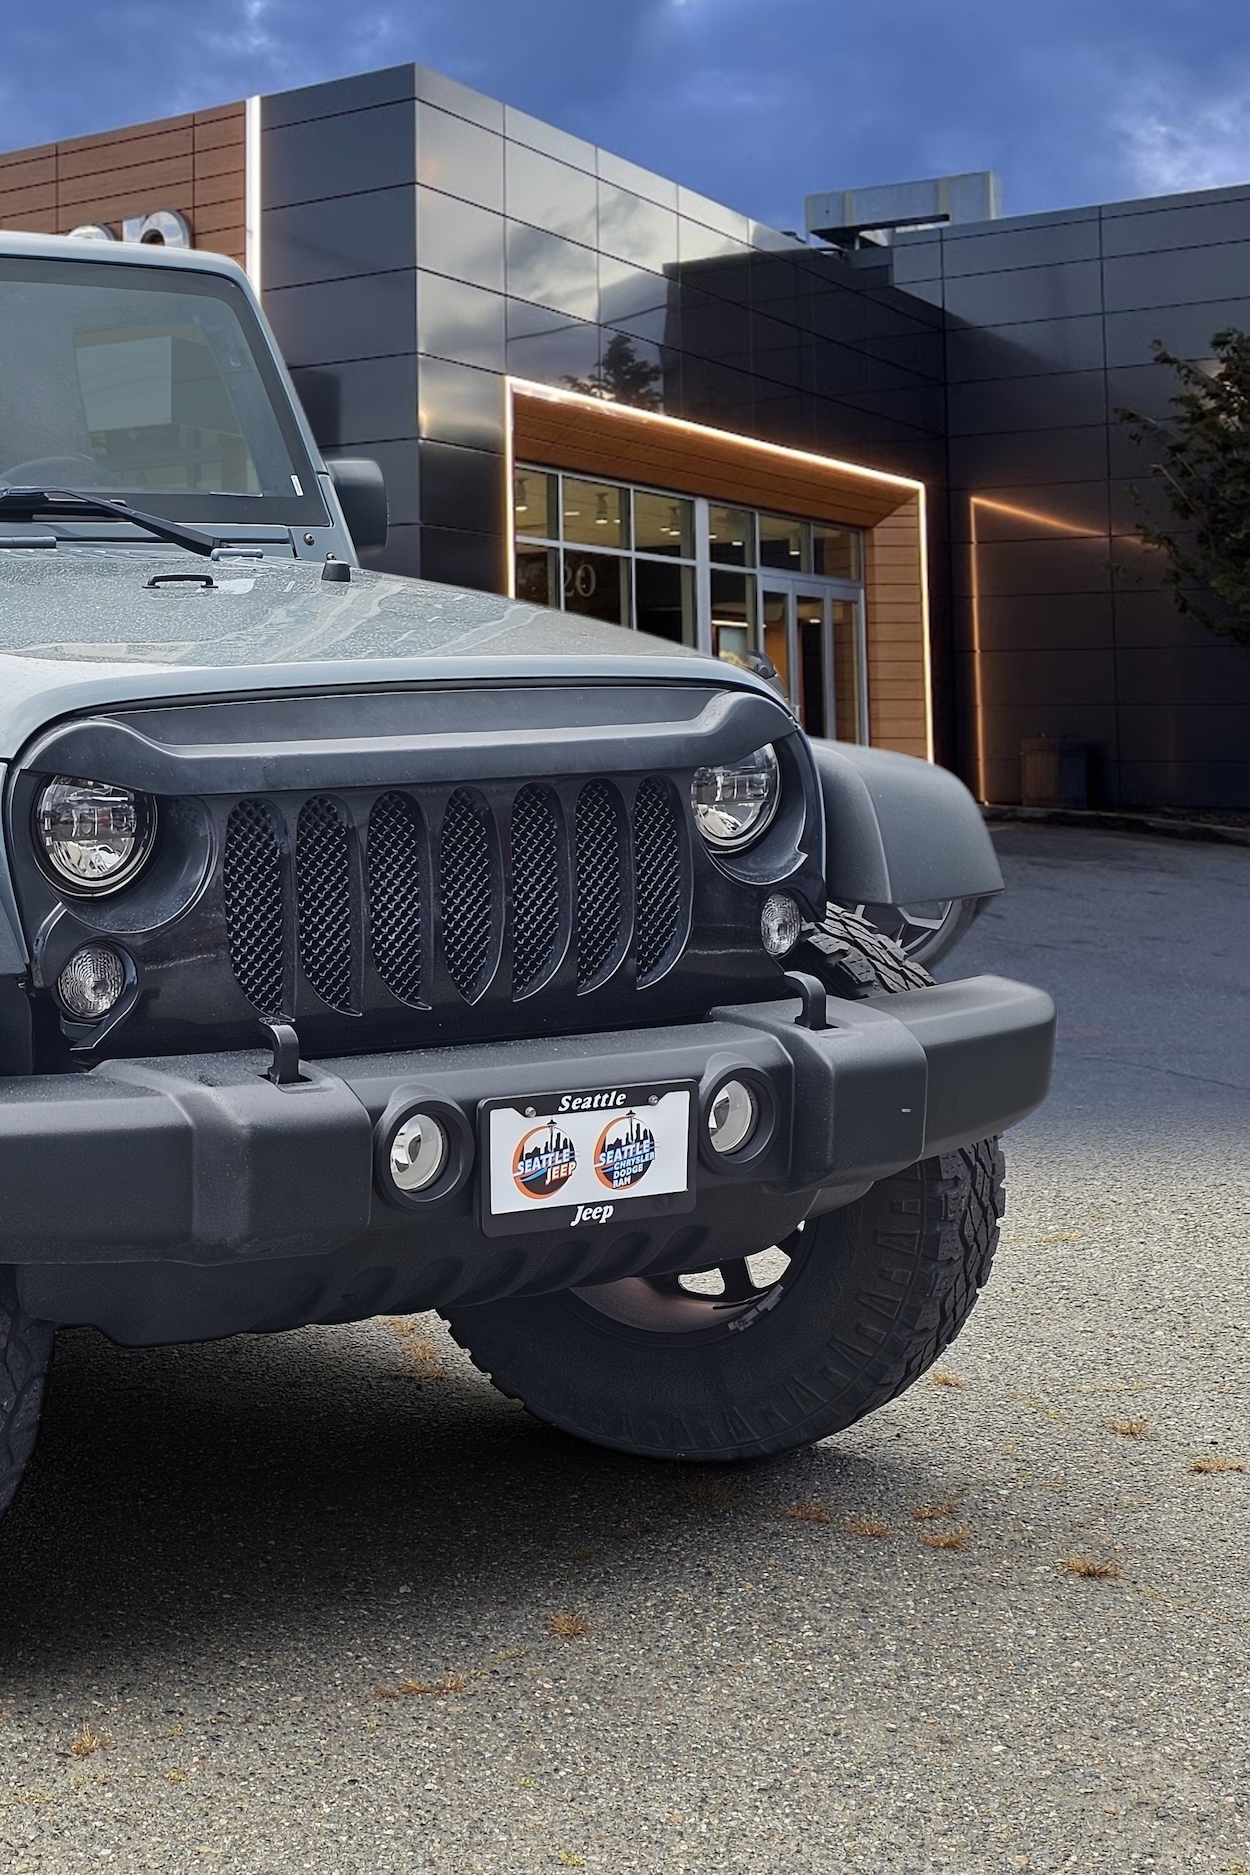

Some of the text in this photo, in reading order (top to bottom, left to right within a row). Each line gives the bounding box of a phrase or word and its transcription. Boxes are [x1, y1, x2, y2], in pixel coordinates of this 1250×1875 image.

[558, 1091, 627, 1112] Seattle
[516, 1148, 570, 1175] SEATTLE
[598, 1140, 651, 1166] SEATTLE
[613, 1151, 655, 1171] CHRYSLER
[545, 1161, 577, 1185] JEEP
[612, 1175, 631, 1189] RAM
[613, 1164, 644, 1180] DODGE
[570, 1204, 614, 1227] Jeep
